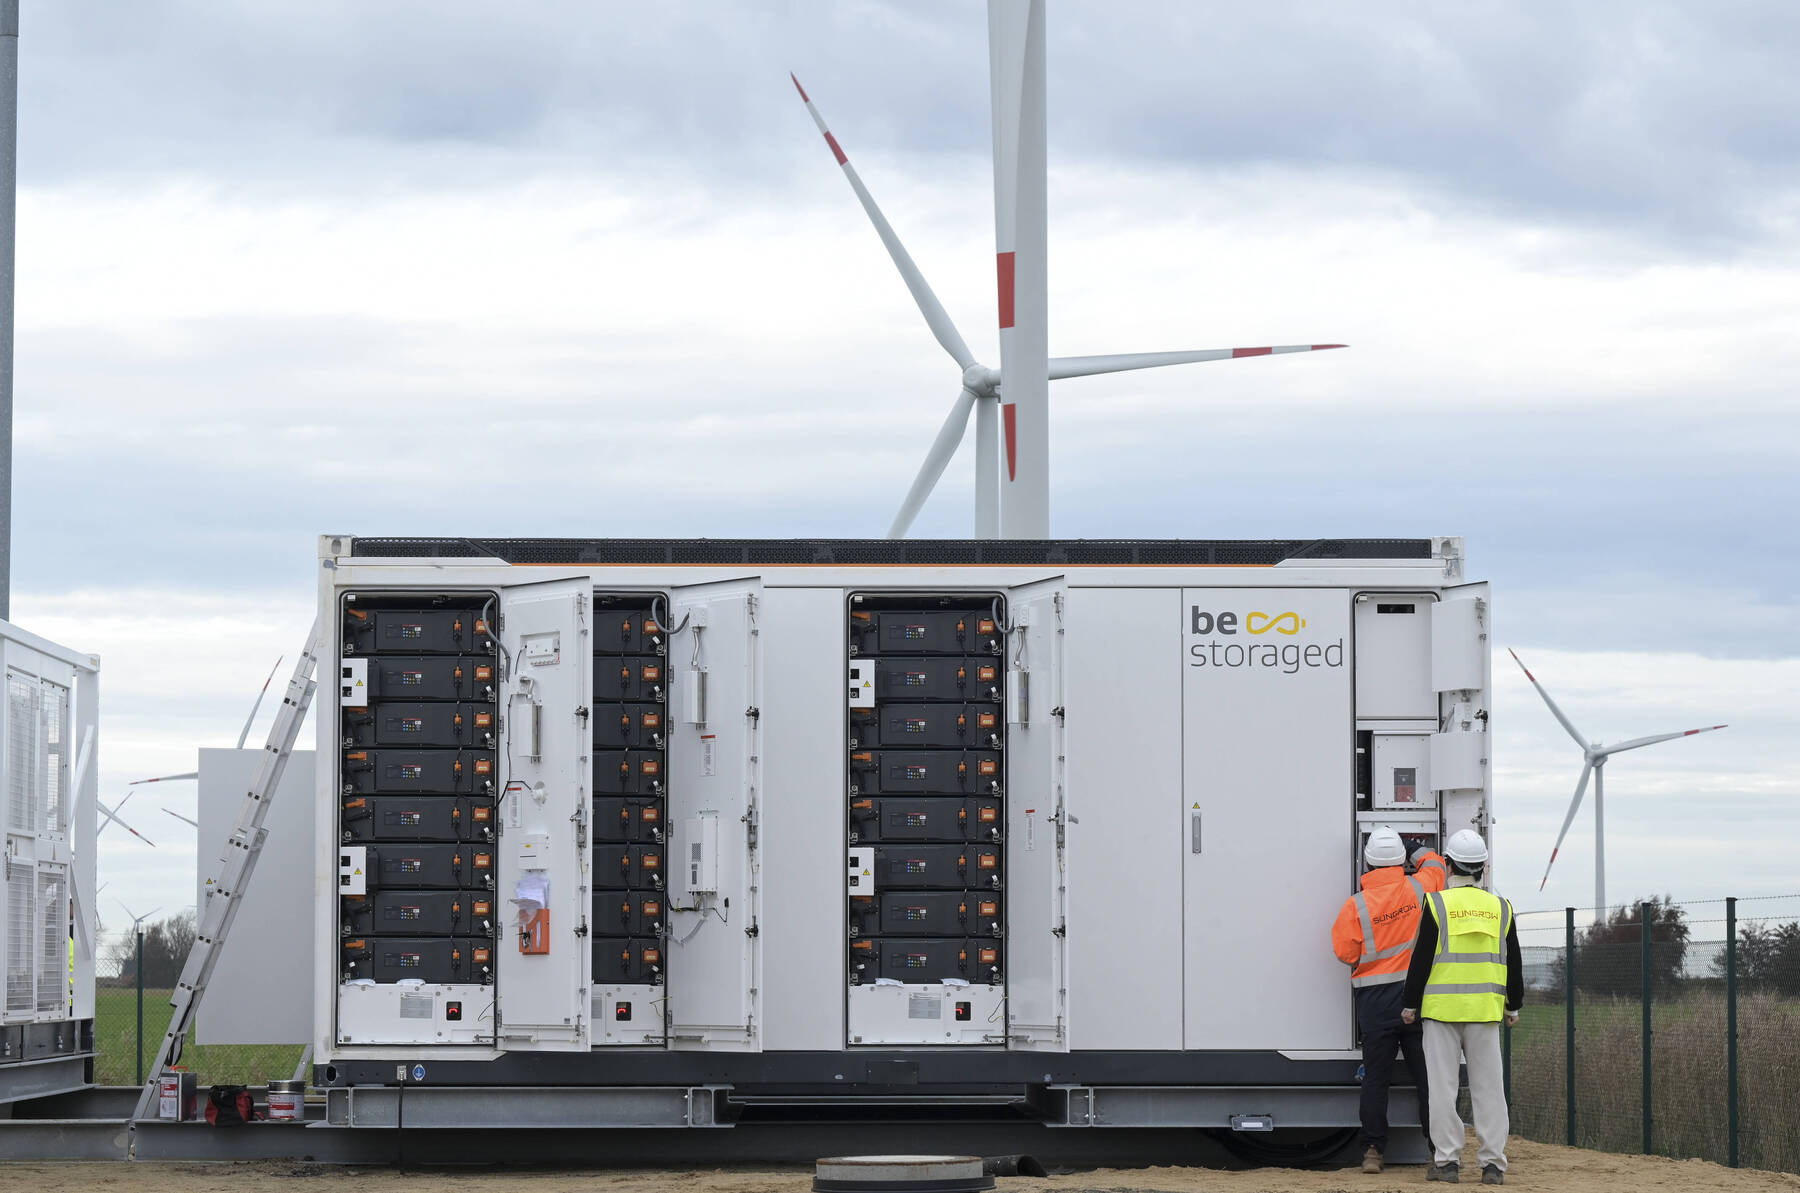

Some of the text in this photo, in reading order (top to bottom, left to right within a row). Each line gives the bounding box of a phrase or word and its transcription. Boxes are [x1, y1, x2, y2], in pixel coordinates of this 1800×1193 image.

[1191, 605, 1237, 635] be
[1190, 638, 1343, 674] storaged
[1373, 903, 1417, 924] SUNGROW
[1449, 910, 1498, 920] SUNGROW
